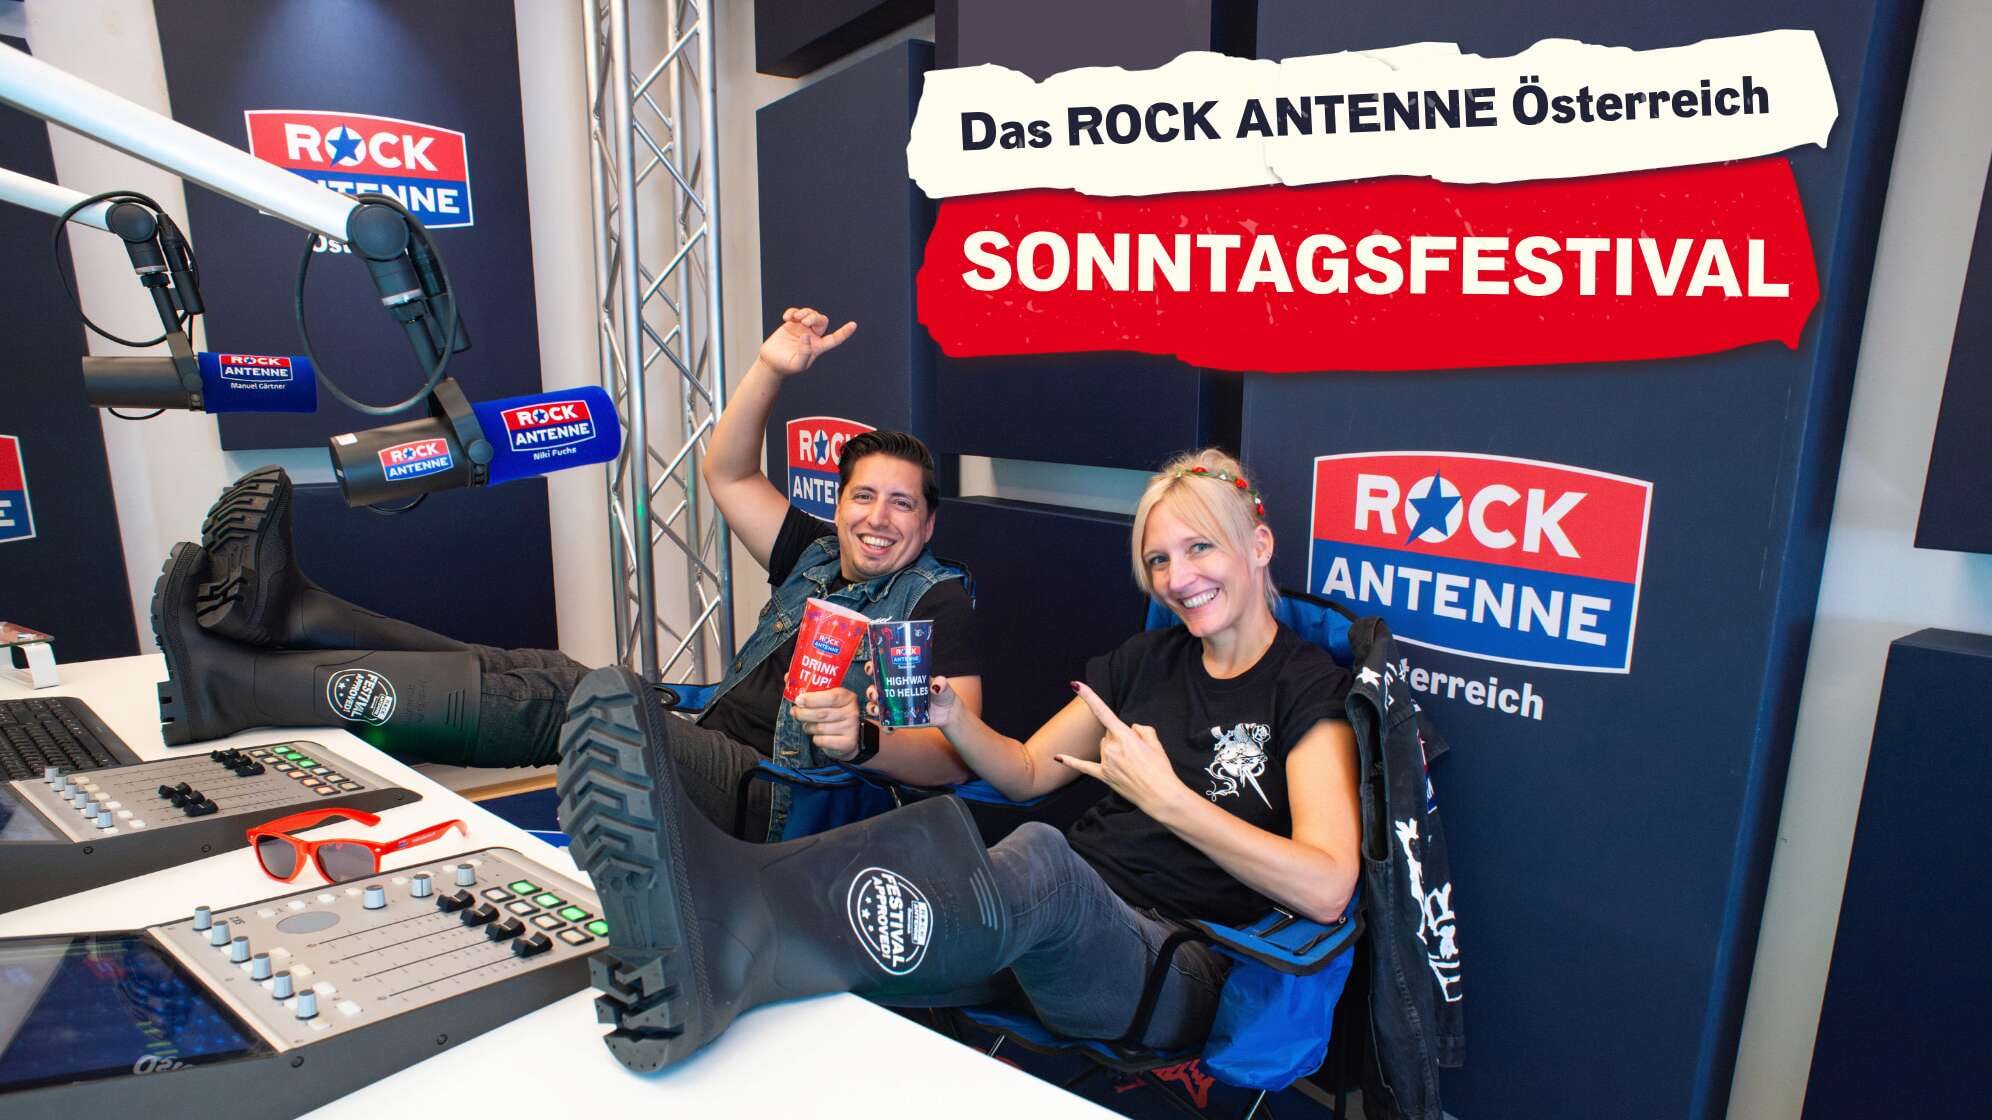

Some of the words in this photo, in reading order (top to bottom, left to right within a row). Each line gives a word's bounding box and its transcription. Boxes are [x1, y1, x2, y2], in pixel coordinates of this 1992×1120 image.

[284, 123, 438, 171] ROCK
[225, 366, 289, 377] ANTENNE
[231, 356, 281, 366] ROCK
[517, 403, 579, 426] ROCK
[515, 422, 590, 446] ANTENNE
[390, 442, 439, 462] ROCK
[533, 451, 550, 461] Niki
[552, 446, 577, 457] Fuchs
[799, 429, 858, 466] ROC
[389, 457, 449, 477] ANTENNE
[793, 475, 839, 505] ANTE
[1354, 472, 1588, 559] ROCK
[1322, 556, 1612, 646] ANTENNE
[801, 655, 839, 676] DRINK
[799, 669, 812, 682] IT
[812, 674, 832, 688] UP!
[886, 675, 927, 686] HIGHWAY
[350, 673, 379, 717] FESTIVAL
[884, 688, 896, 698] TO
[897, 687, 928, 698] HELLES
[872, 876, 892, 960] APPROVED!
[881, 873, 905, 967] FESTIVAL
